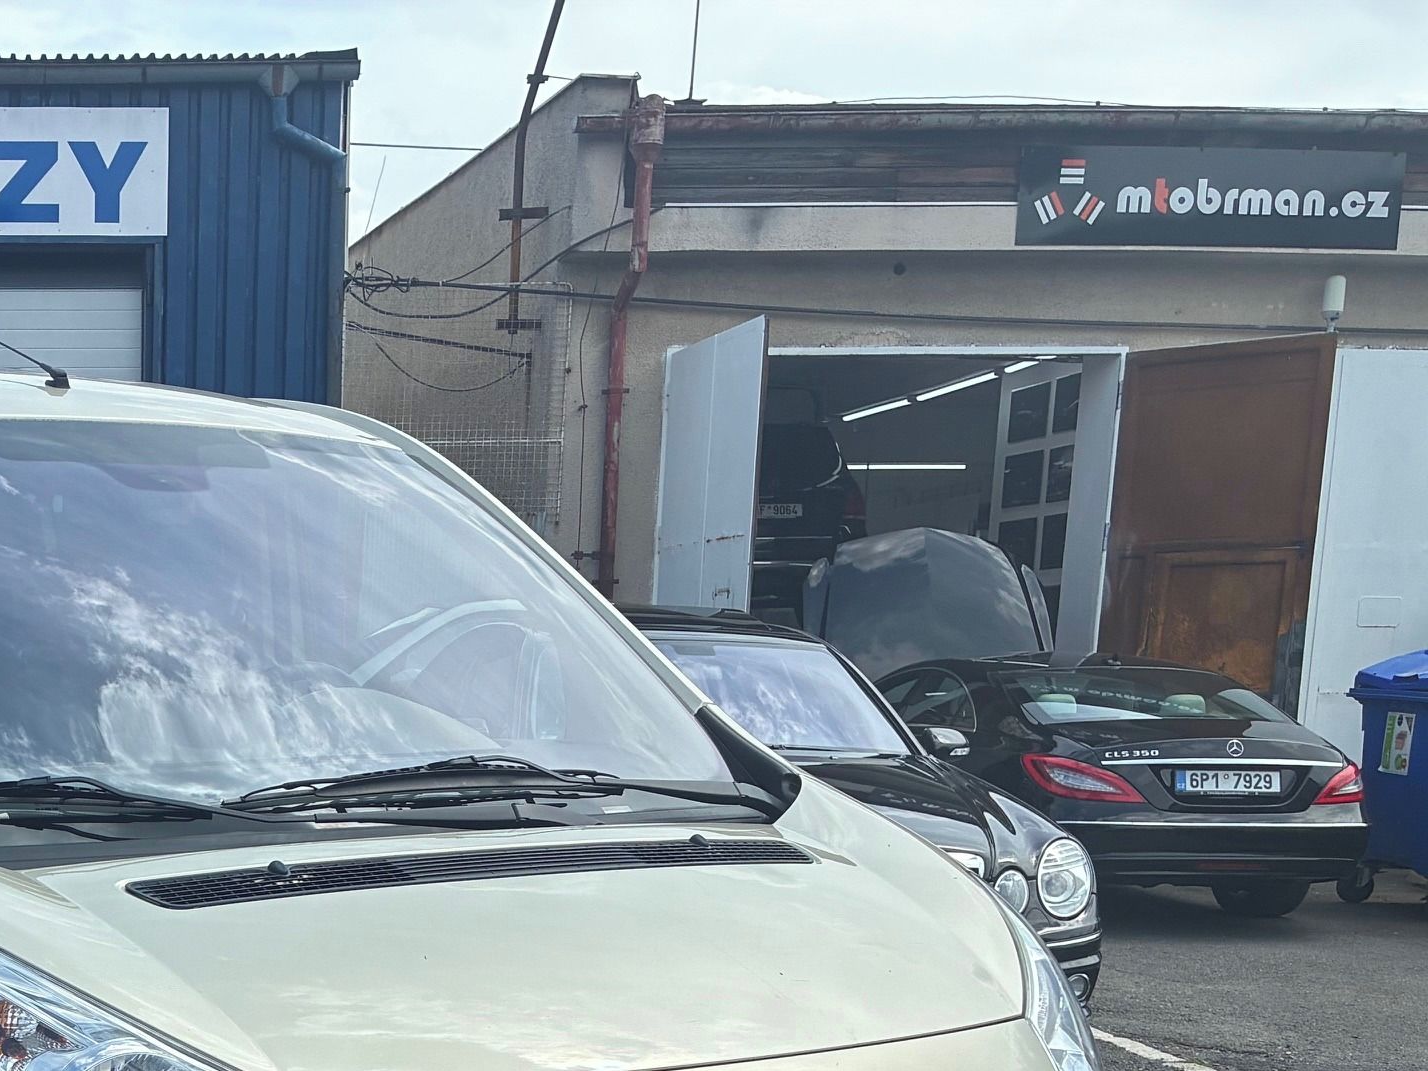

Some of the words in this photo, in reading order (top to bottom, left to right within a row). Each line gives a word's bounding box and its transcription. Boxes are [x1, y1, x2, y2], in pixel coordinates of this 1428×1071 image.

[1116, 178, 1390, 218] mtobrman.cz
[1105, 750, 1129, 758] CLS
[1133, 749, 1160, 757] 350
[1189, 772, 1219, 790] 6P1
[1232, 773, 1273, 791] 7929
